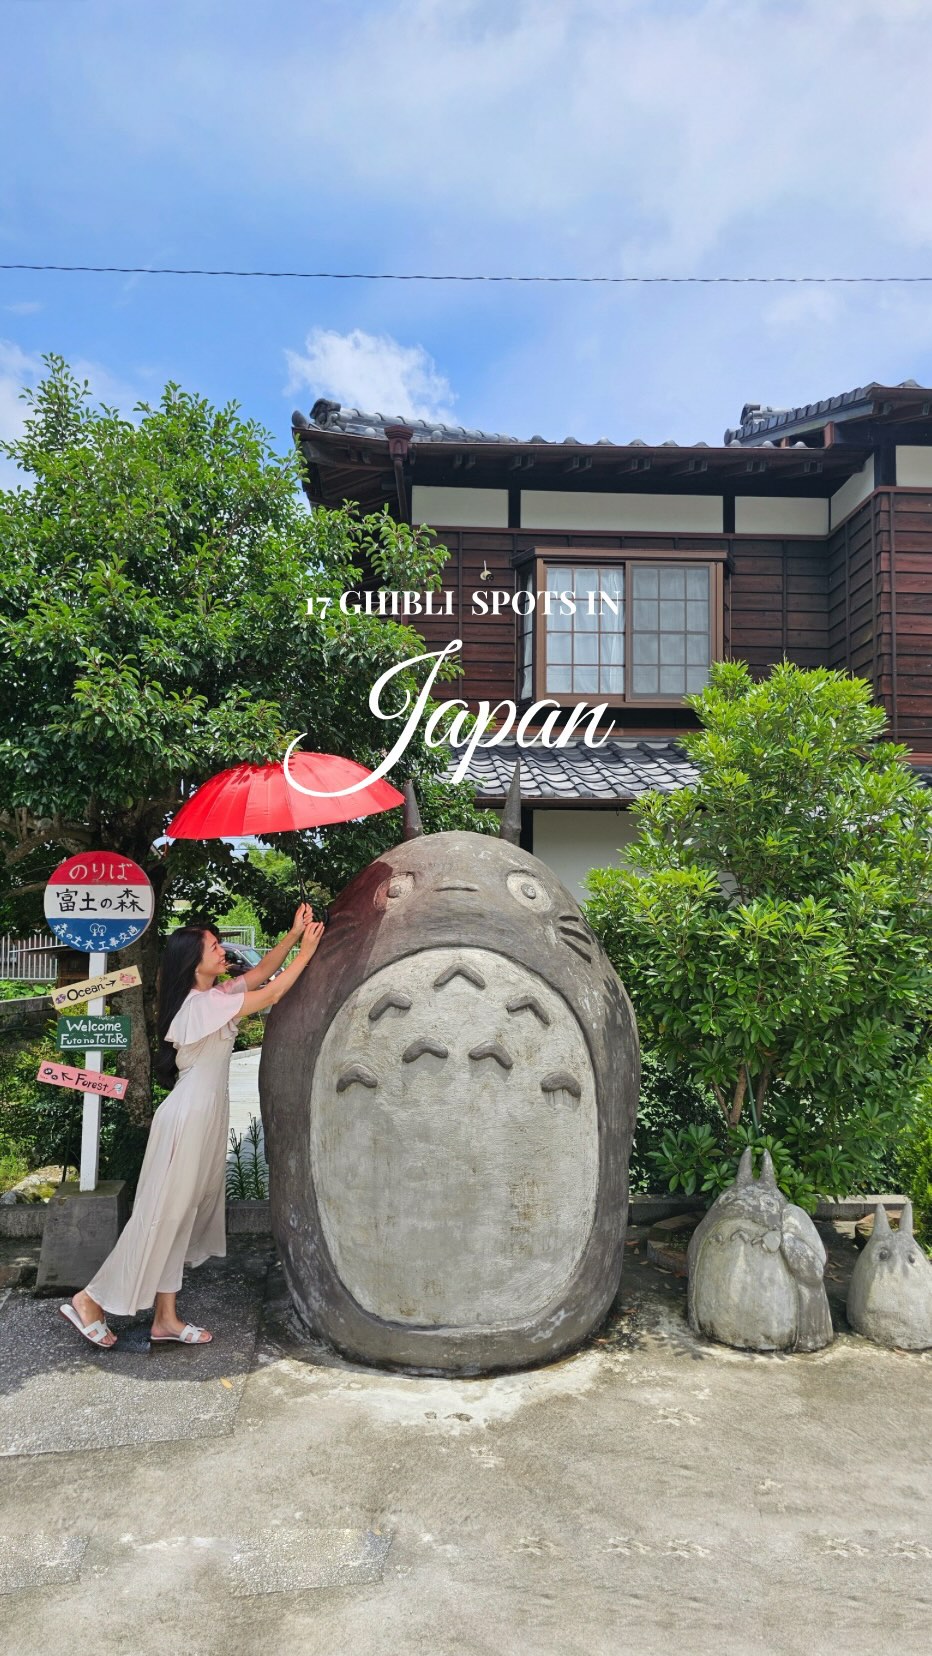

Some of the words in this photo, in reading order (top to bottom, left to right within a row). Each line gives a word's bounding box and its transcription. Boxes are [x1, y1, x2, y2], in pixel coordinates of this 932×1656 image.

[68, 862, 133, 881] のりば
[67, 983, 105, 1001] Ocean
[65, 1020, 122, 1033] Welcome
[60, 1033, 82, 1045] Futo
[75, 1073, 109, 1092] Forest
